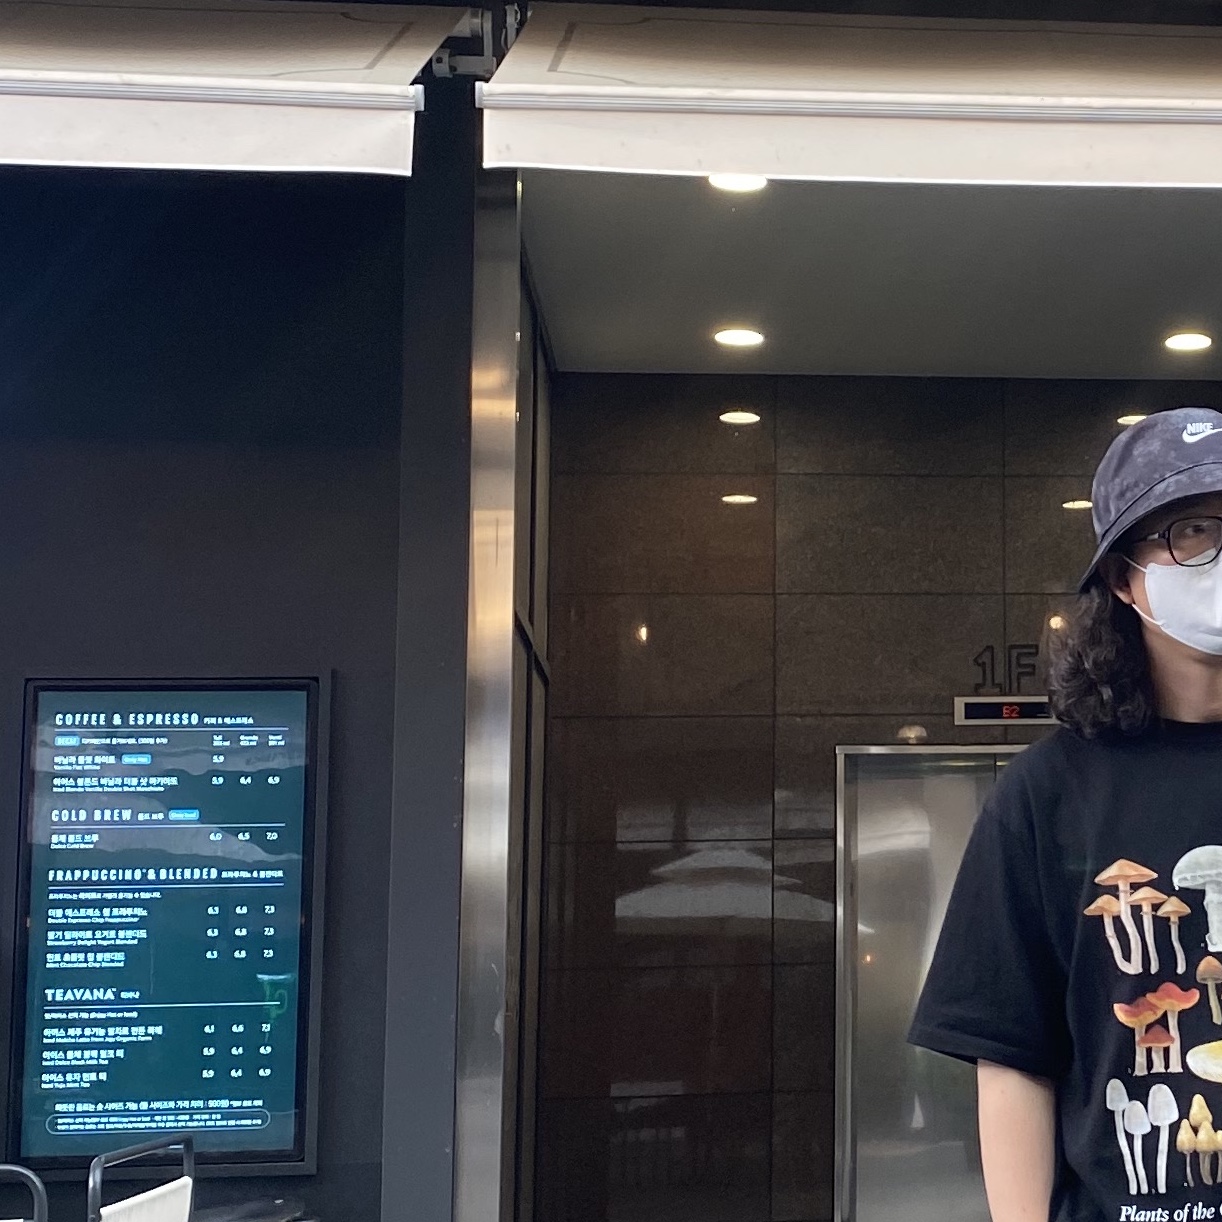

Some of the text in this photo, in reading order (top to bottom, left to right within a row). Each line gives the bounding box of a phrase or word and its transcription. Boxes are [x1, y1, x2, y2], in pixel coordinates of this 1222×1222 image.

[1186, 422, 1214, 435] NIKE
[973, 643, 1039, 694] 1F
[55, 713, 106, 726] COFFEE
[112, 713, 122, 725] &
[129, 713, 199, 725] ESPRESSO
[51, 810, 87, 821] COLD
[93, 809, 132, 821] BREW
[147, 868, 156, 880] &
[159, 868, 218, 880] BLENDED
[44, 988, 116, 1001] TEAVANA
[1119, 1205, 1170, 1222] Plants
[1193, 1201, 1216, 1221] the
